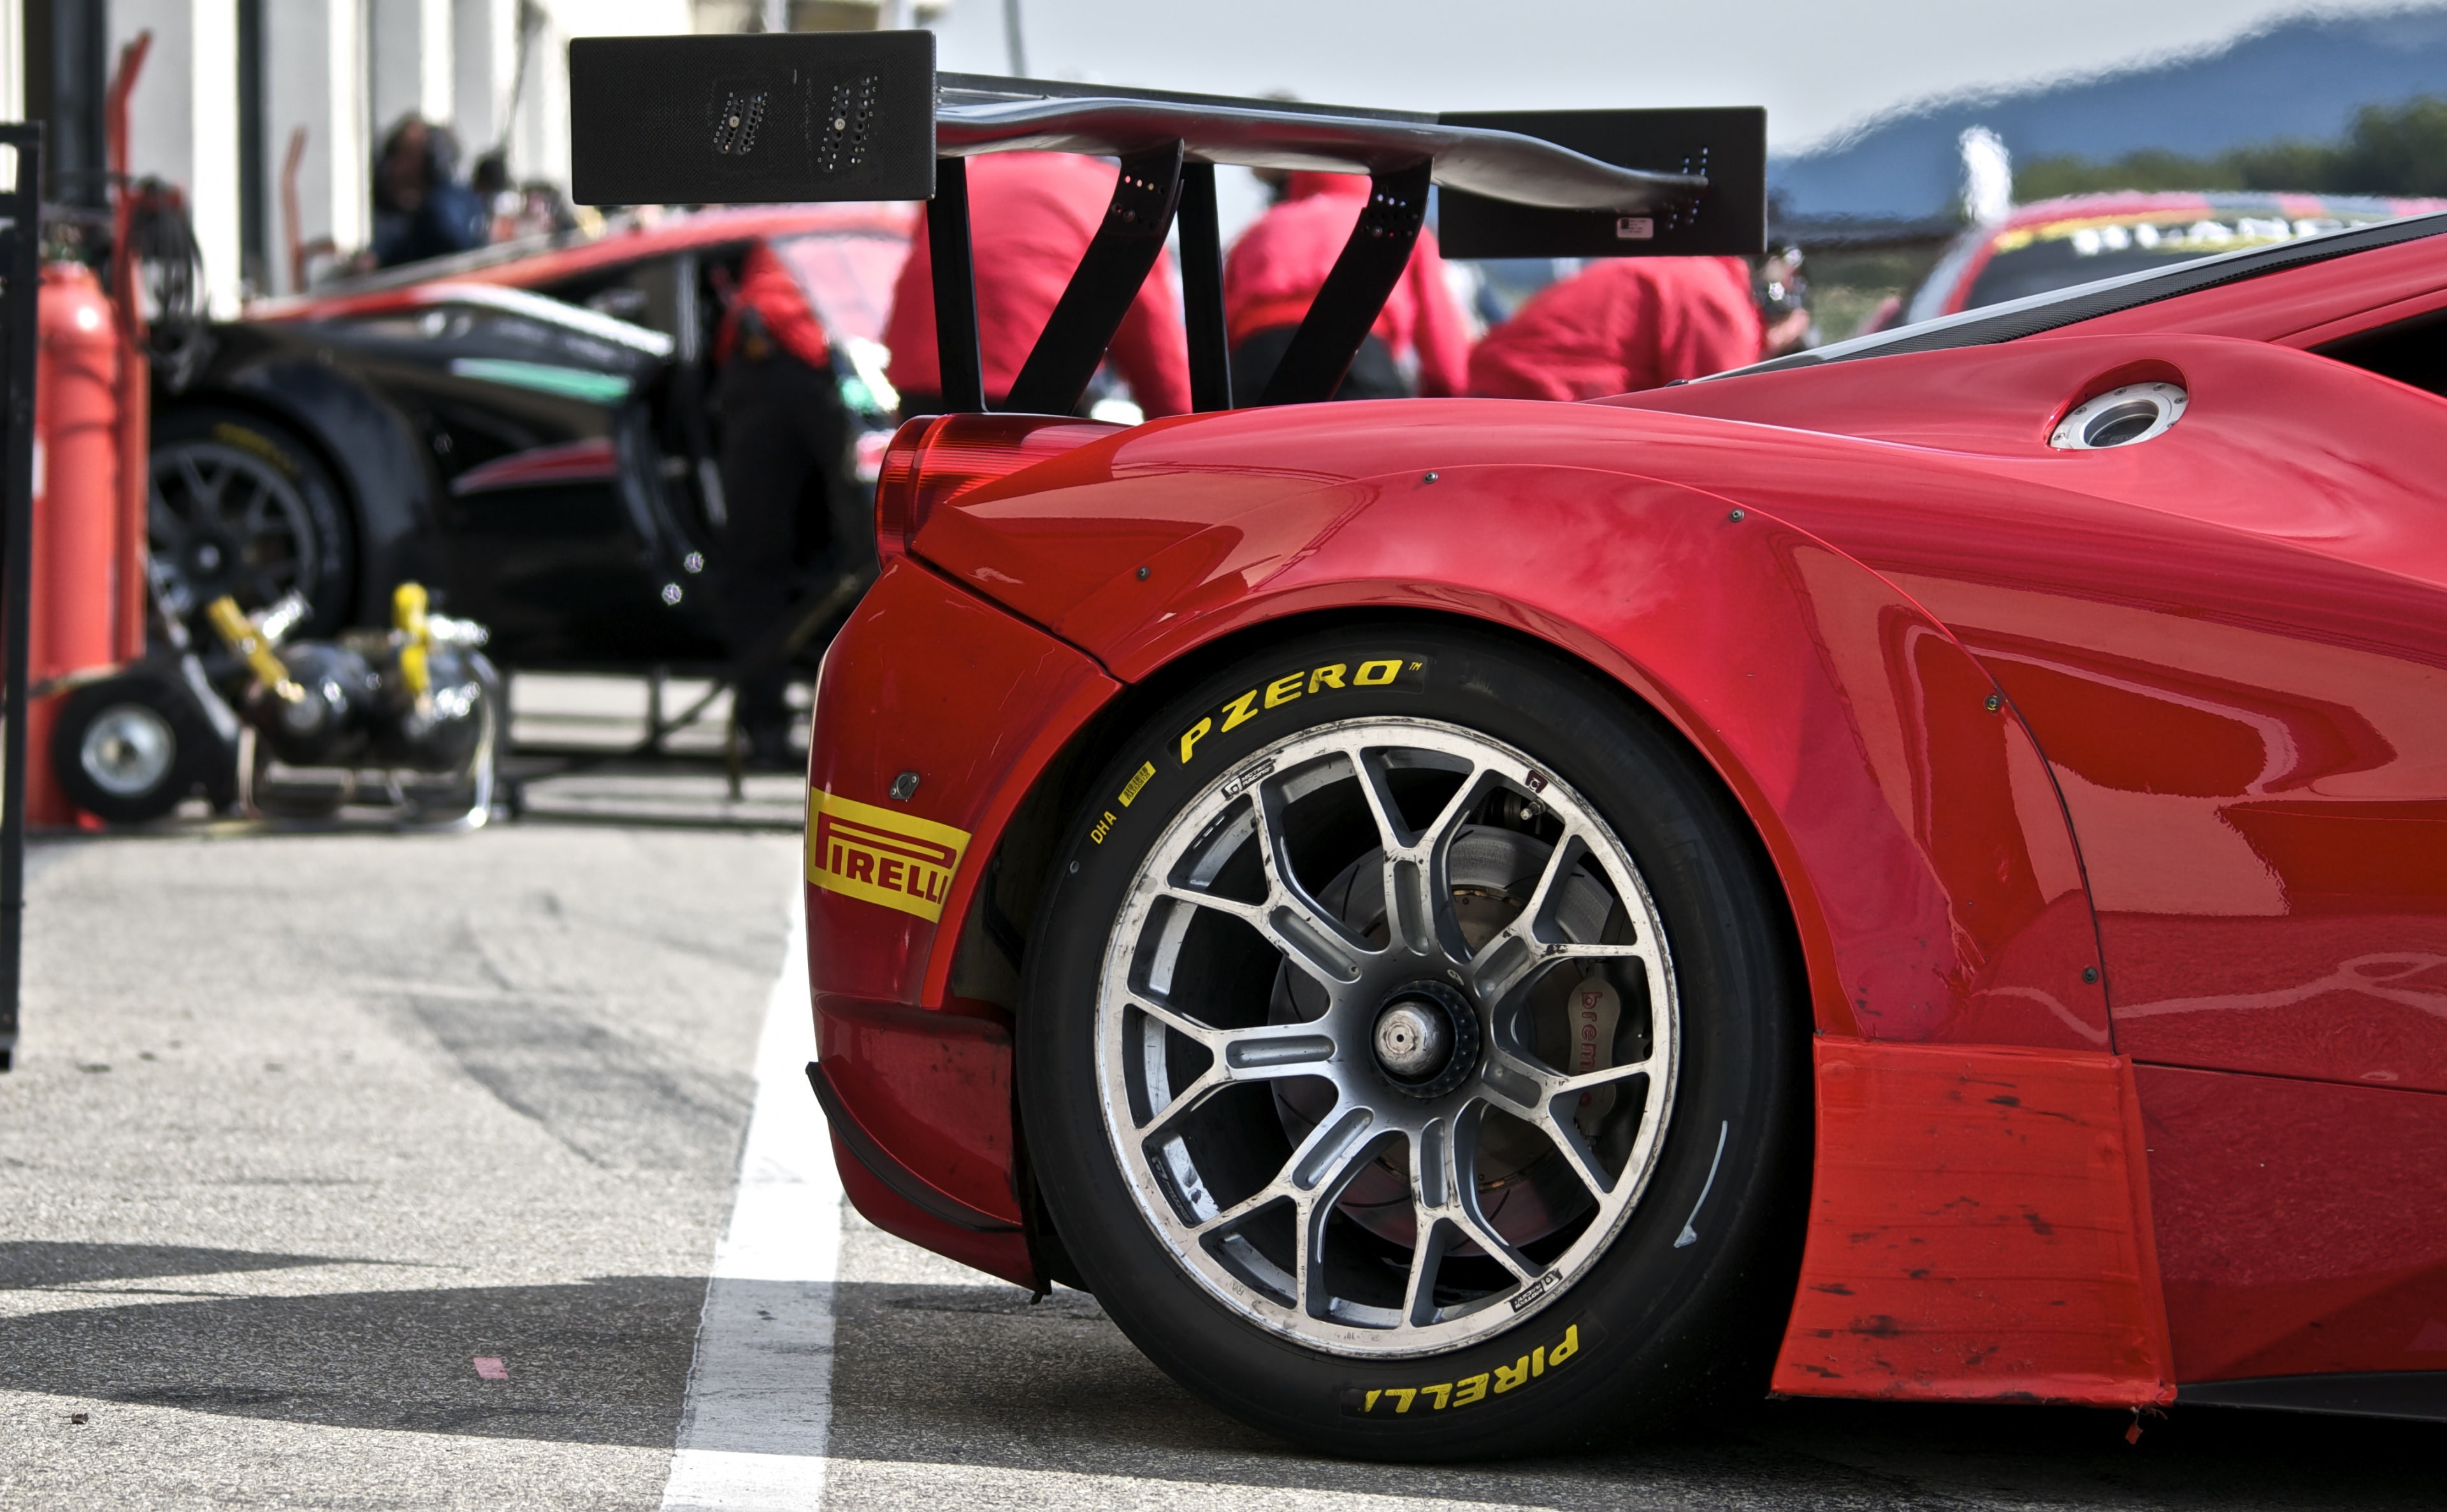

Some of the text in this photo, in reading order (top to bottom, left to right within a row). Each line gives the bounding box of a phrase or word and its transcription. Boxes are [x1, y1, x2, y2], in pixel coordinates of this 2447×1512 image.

[814, 810, 957, 905] PIRELLI
[1090, 810, 1118, 845] DHA
[1578, 991, 1603, 1107] bremo
[1364, 1324, 1579, 1413] PIRELLI
